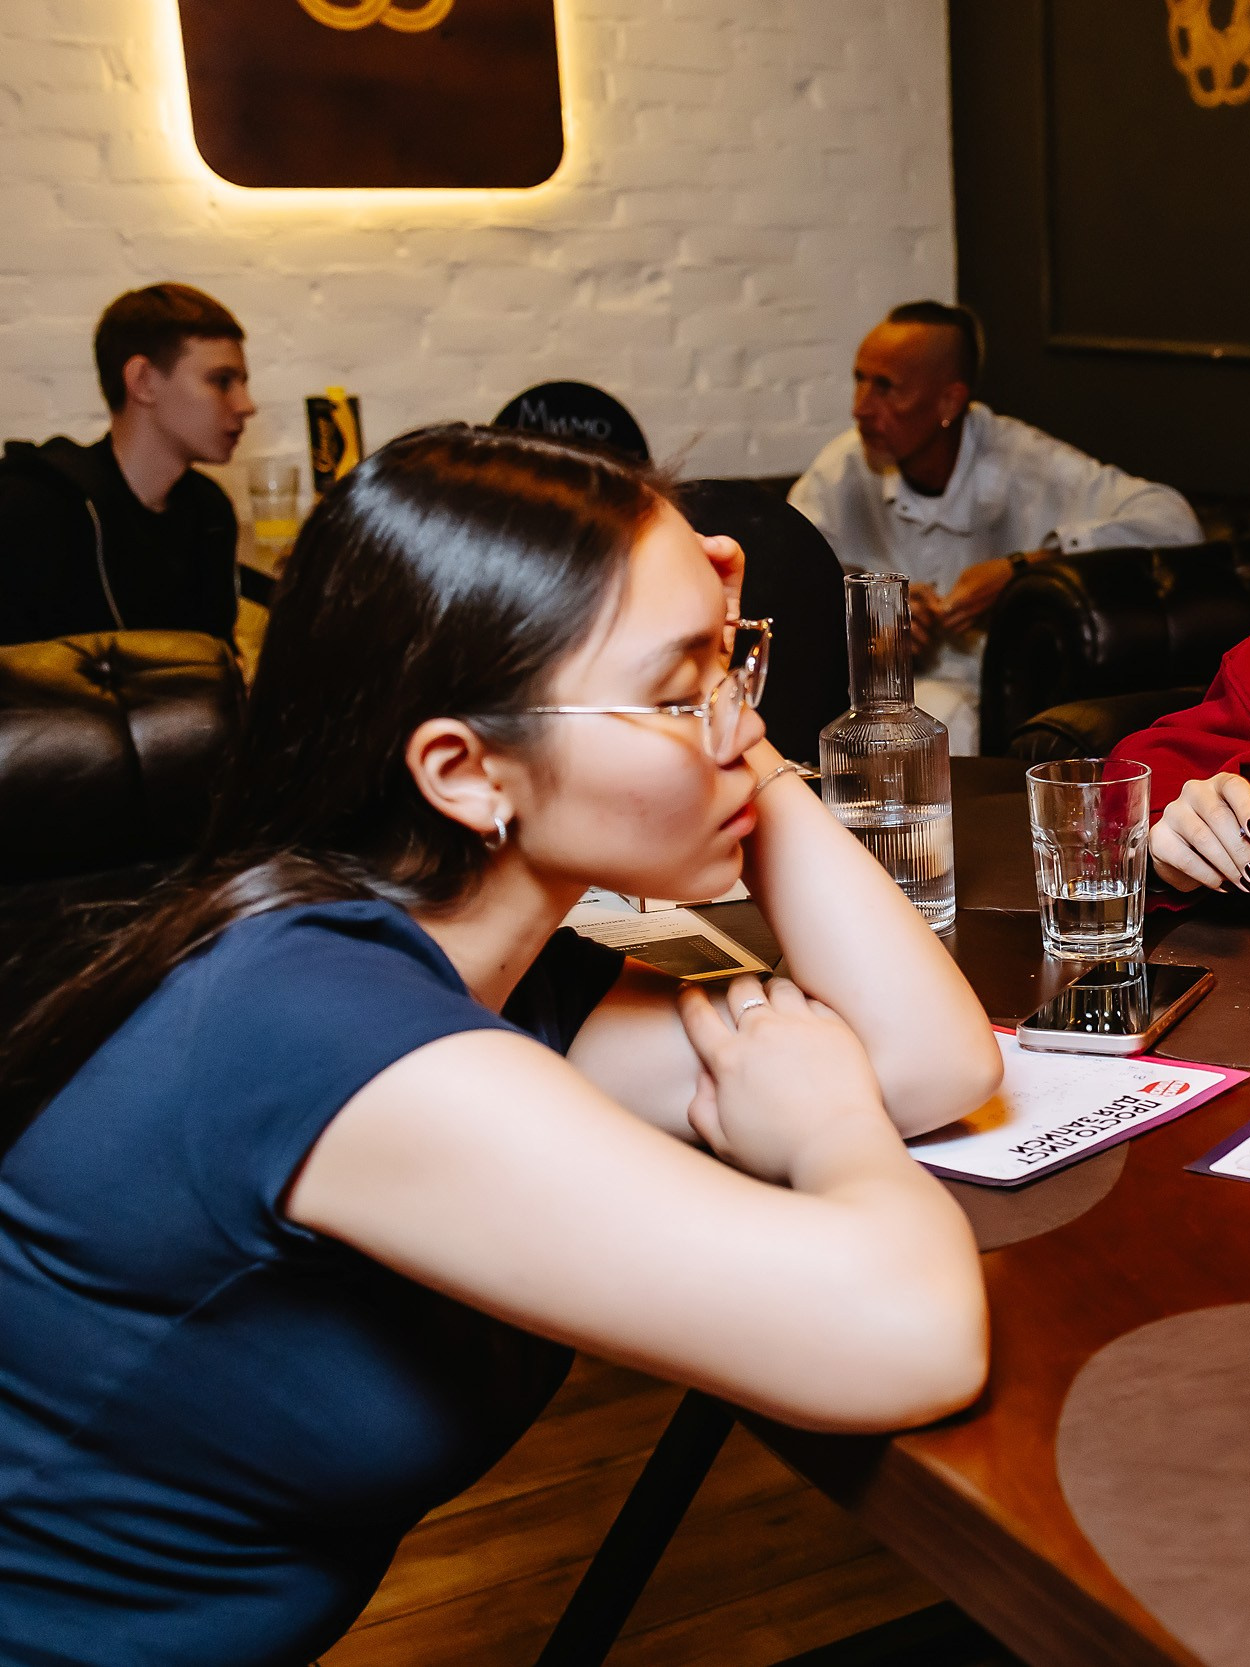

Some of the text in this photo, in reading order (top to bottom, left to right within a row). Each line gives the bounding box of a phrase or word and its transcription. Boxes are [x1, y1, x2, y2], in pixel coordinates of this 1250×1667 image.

[1008, 1094, 1142, 1155] ДЛЯ ЗАПИСИ
[1016, 1099, 1163, 1165] ПРОСТО ЛИСТ
